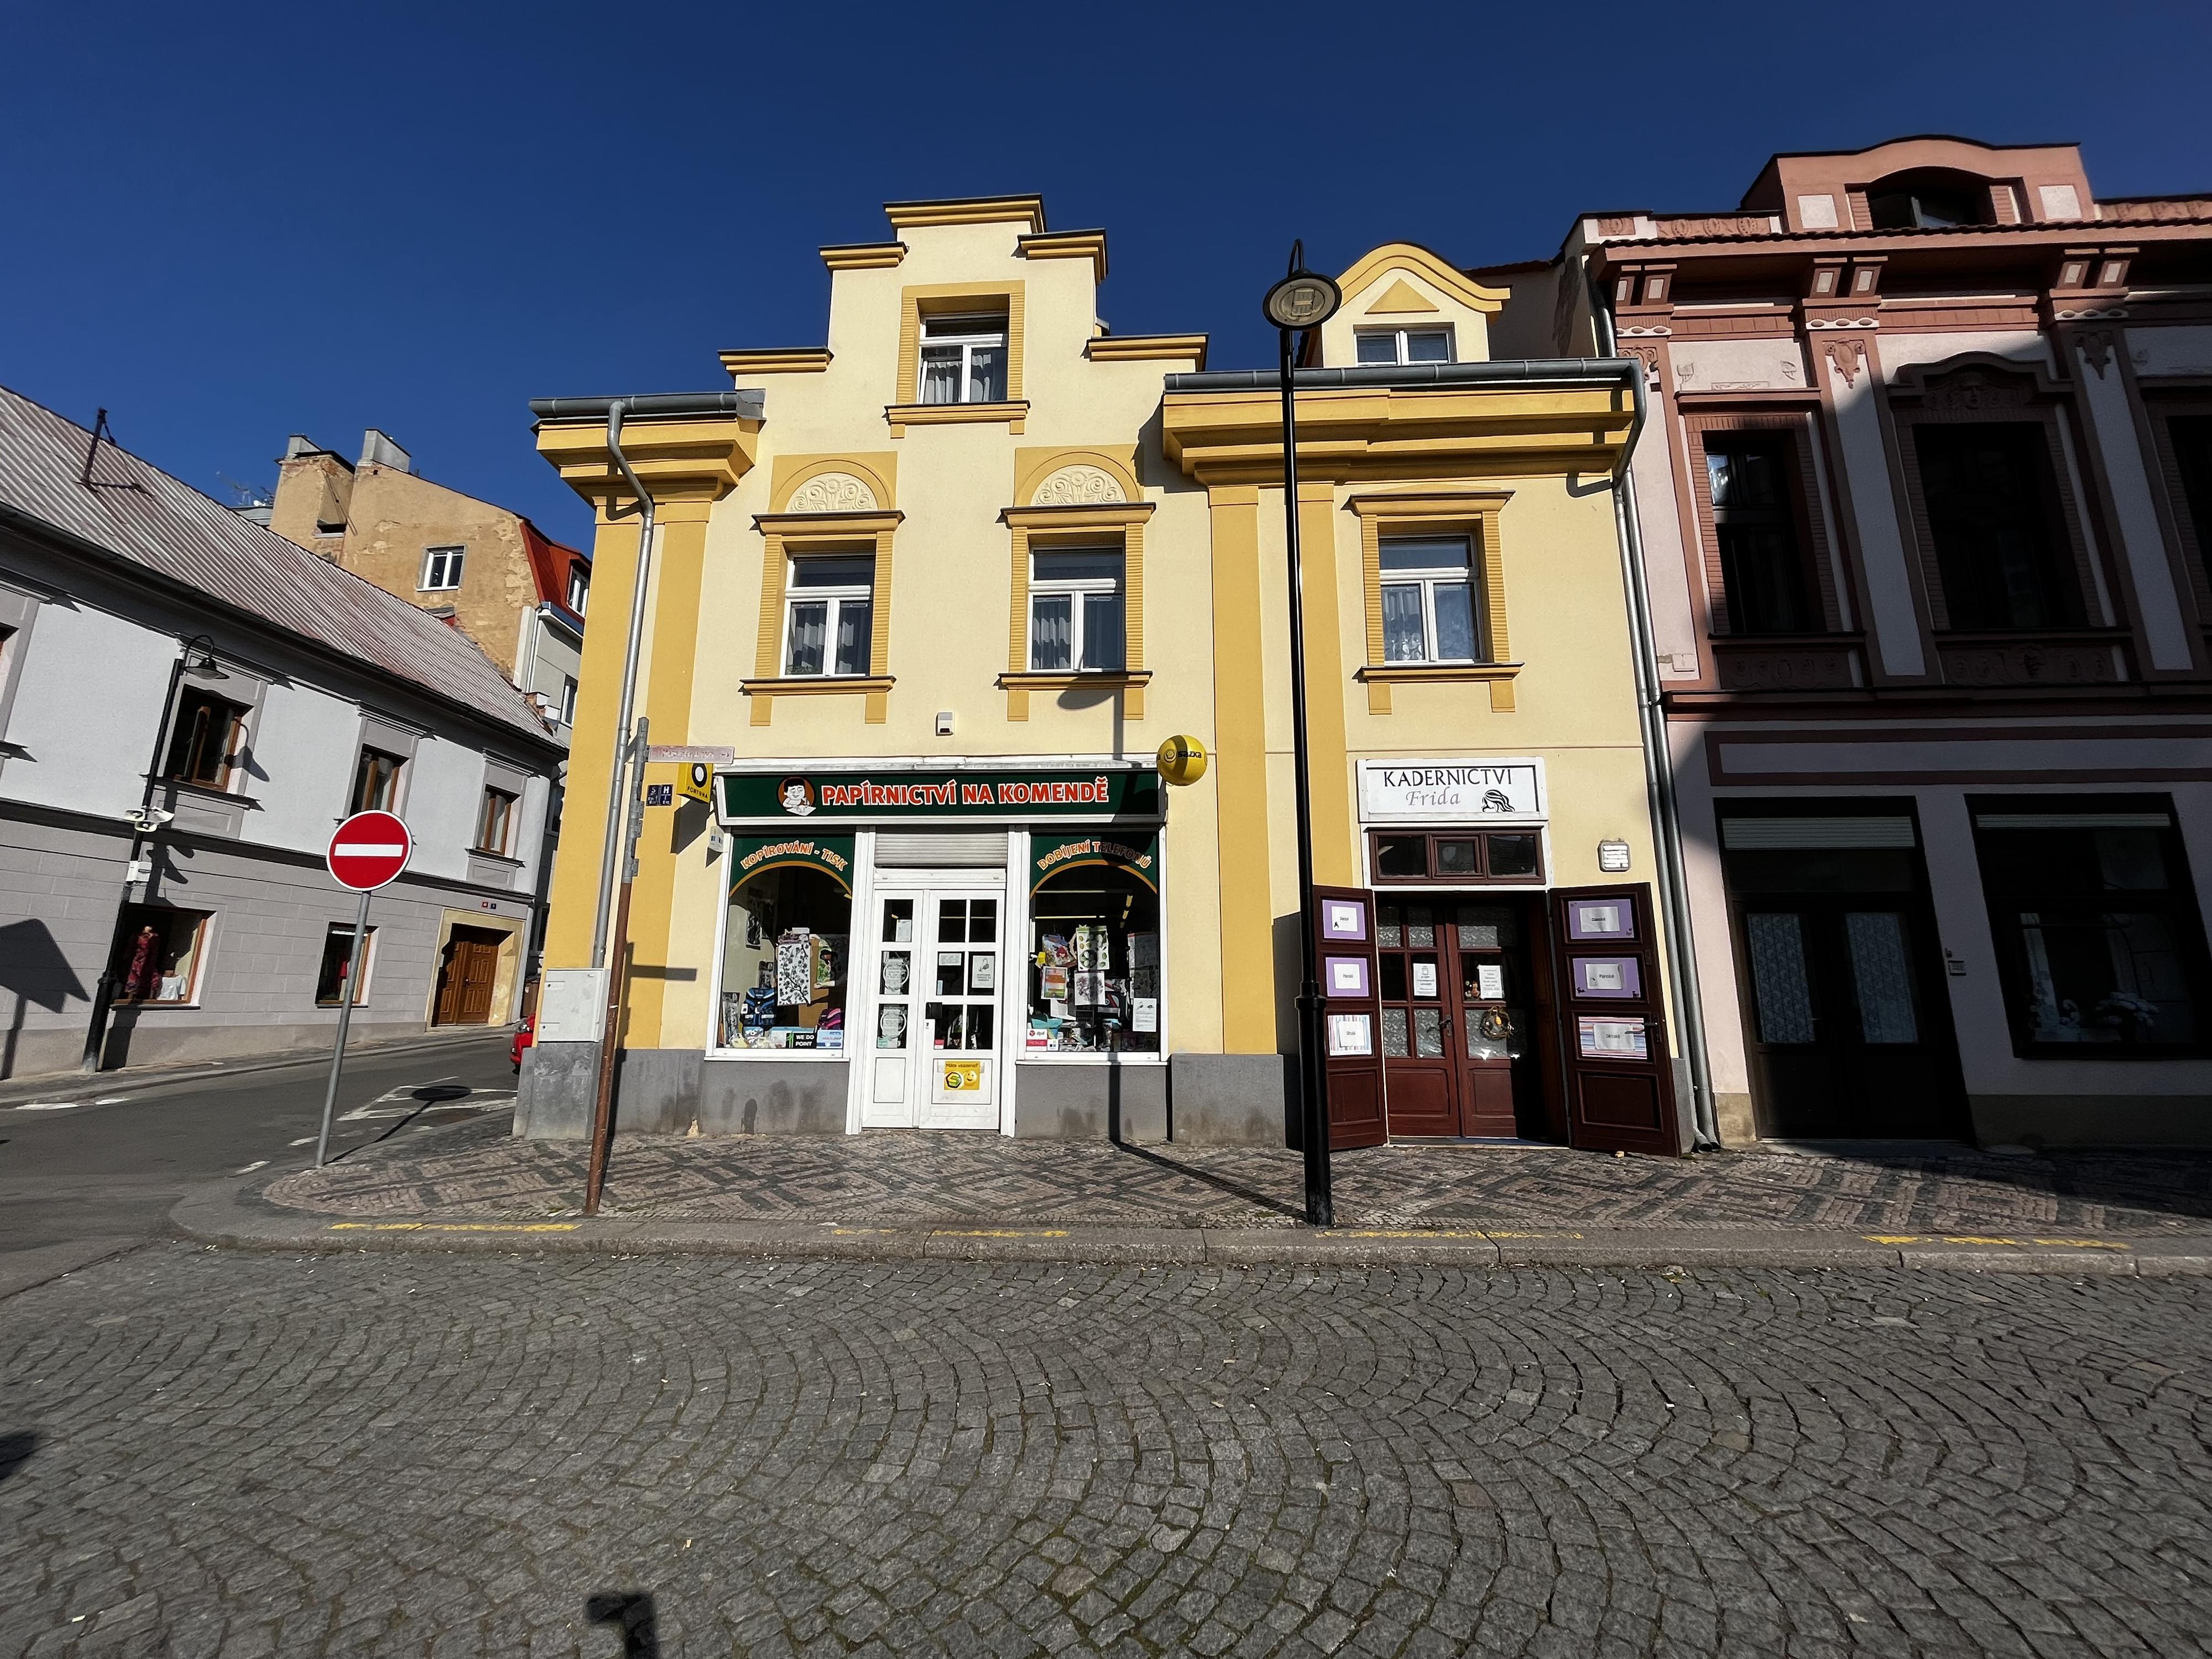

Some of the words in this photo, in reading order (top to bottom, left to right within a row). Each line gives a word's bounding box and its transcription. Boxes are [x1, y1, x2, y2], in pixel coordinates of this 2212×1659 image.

[686, 786, 708, 799] FORTUNA
[822, 779, 957, 806] PAPÍRNICTVÍ
[962, 784, 995, 805] NA
[998, 776, 1109, 804] KOMENDĚ
[1406, 786, 1461, 806] Frida
[740, 840, 815, 869] KOPÍROVÁNÍ
[821, 848, 848, 872] TISK
[1037, 839, 1091, 870] DOBÍJENÍ
[1092, 841, 1152, 869] TELEFONŮ
